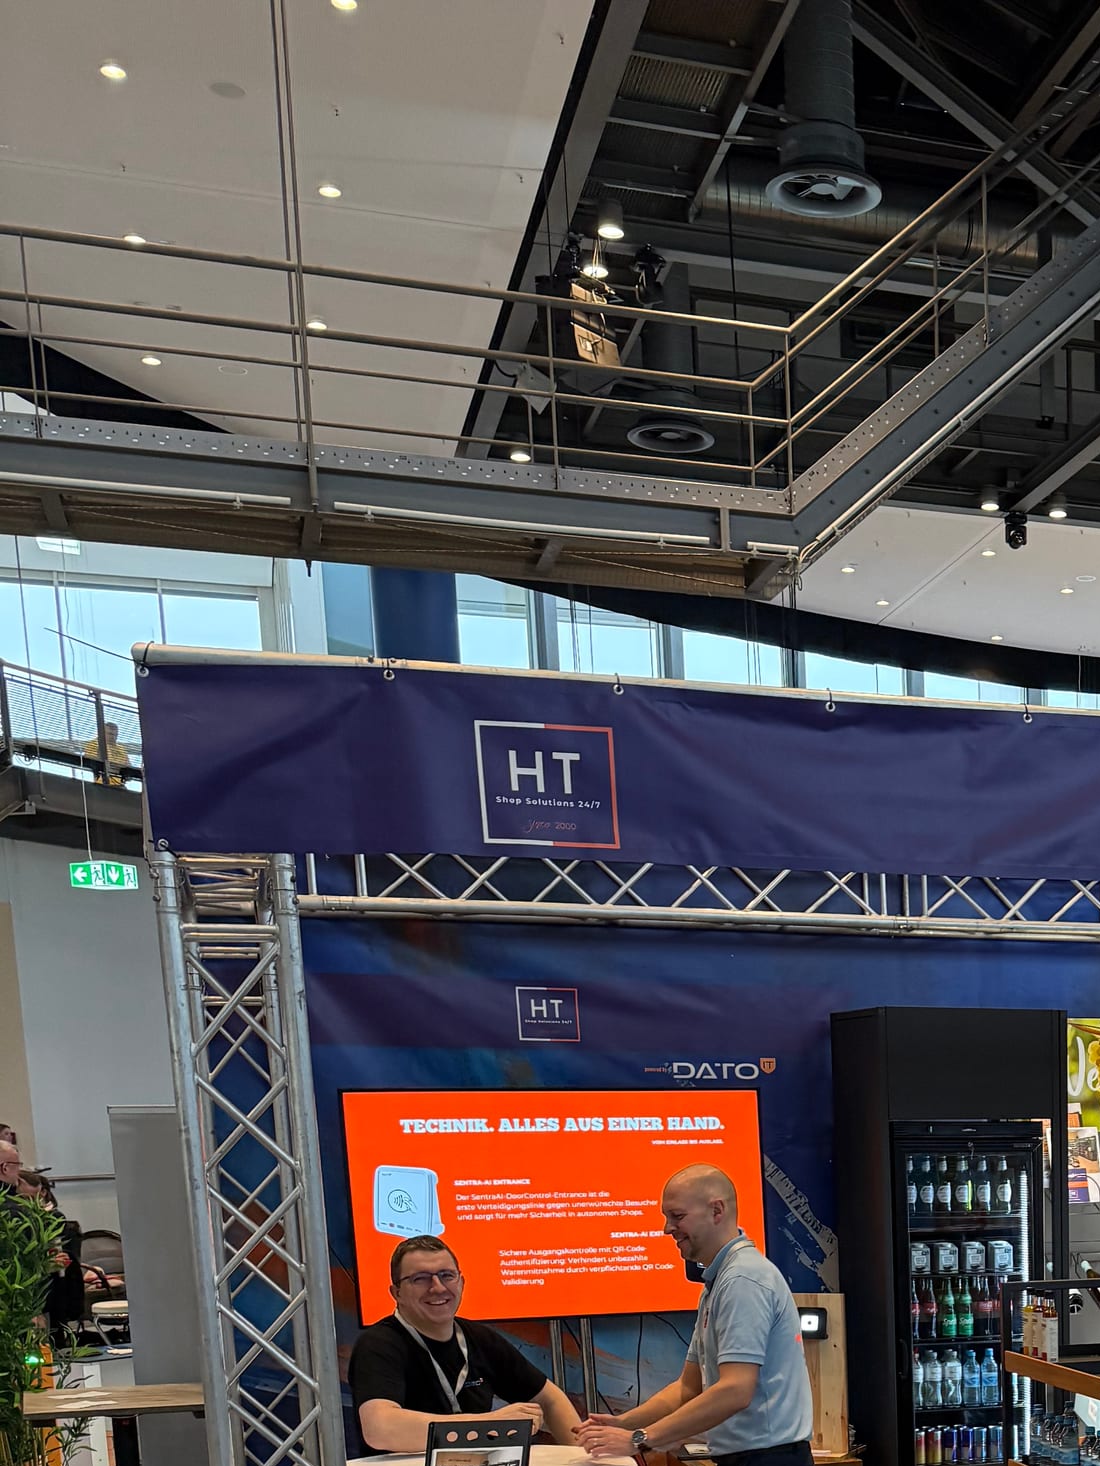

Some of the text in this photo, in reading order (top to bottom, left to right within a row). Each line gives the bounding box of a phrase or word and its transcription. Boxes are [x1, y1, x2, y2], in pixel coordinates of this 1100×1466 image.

[508, 750, 580, 794] HT
[495, 796, 601, 809] Shop Solutions 24/7
[530, 999, 563, 1018] HT
[673, 1062, 760, 1080] DATO
[400, 1116, 725, 1133] TECHNIK. ALLES AUS EINER HAND.
[455, 1193, 469, 1201] Der
[546, 1202, 570, 1210] gegen
[625, 1199, 658, 1207] Besucher
[457, 1213, 473, 1221] und
[474, 1213, 494, 1222] sorgt
